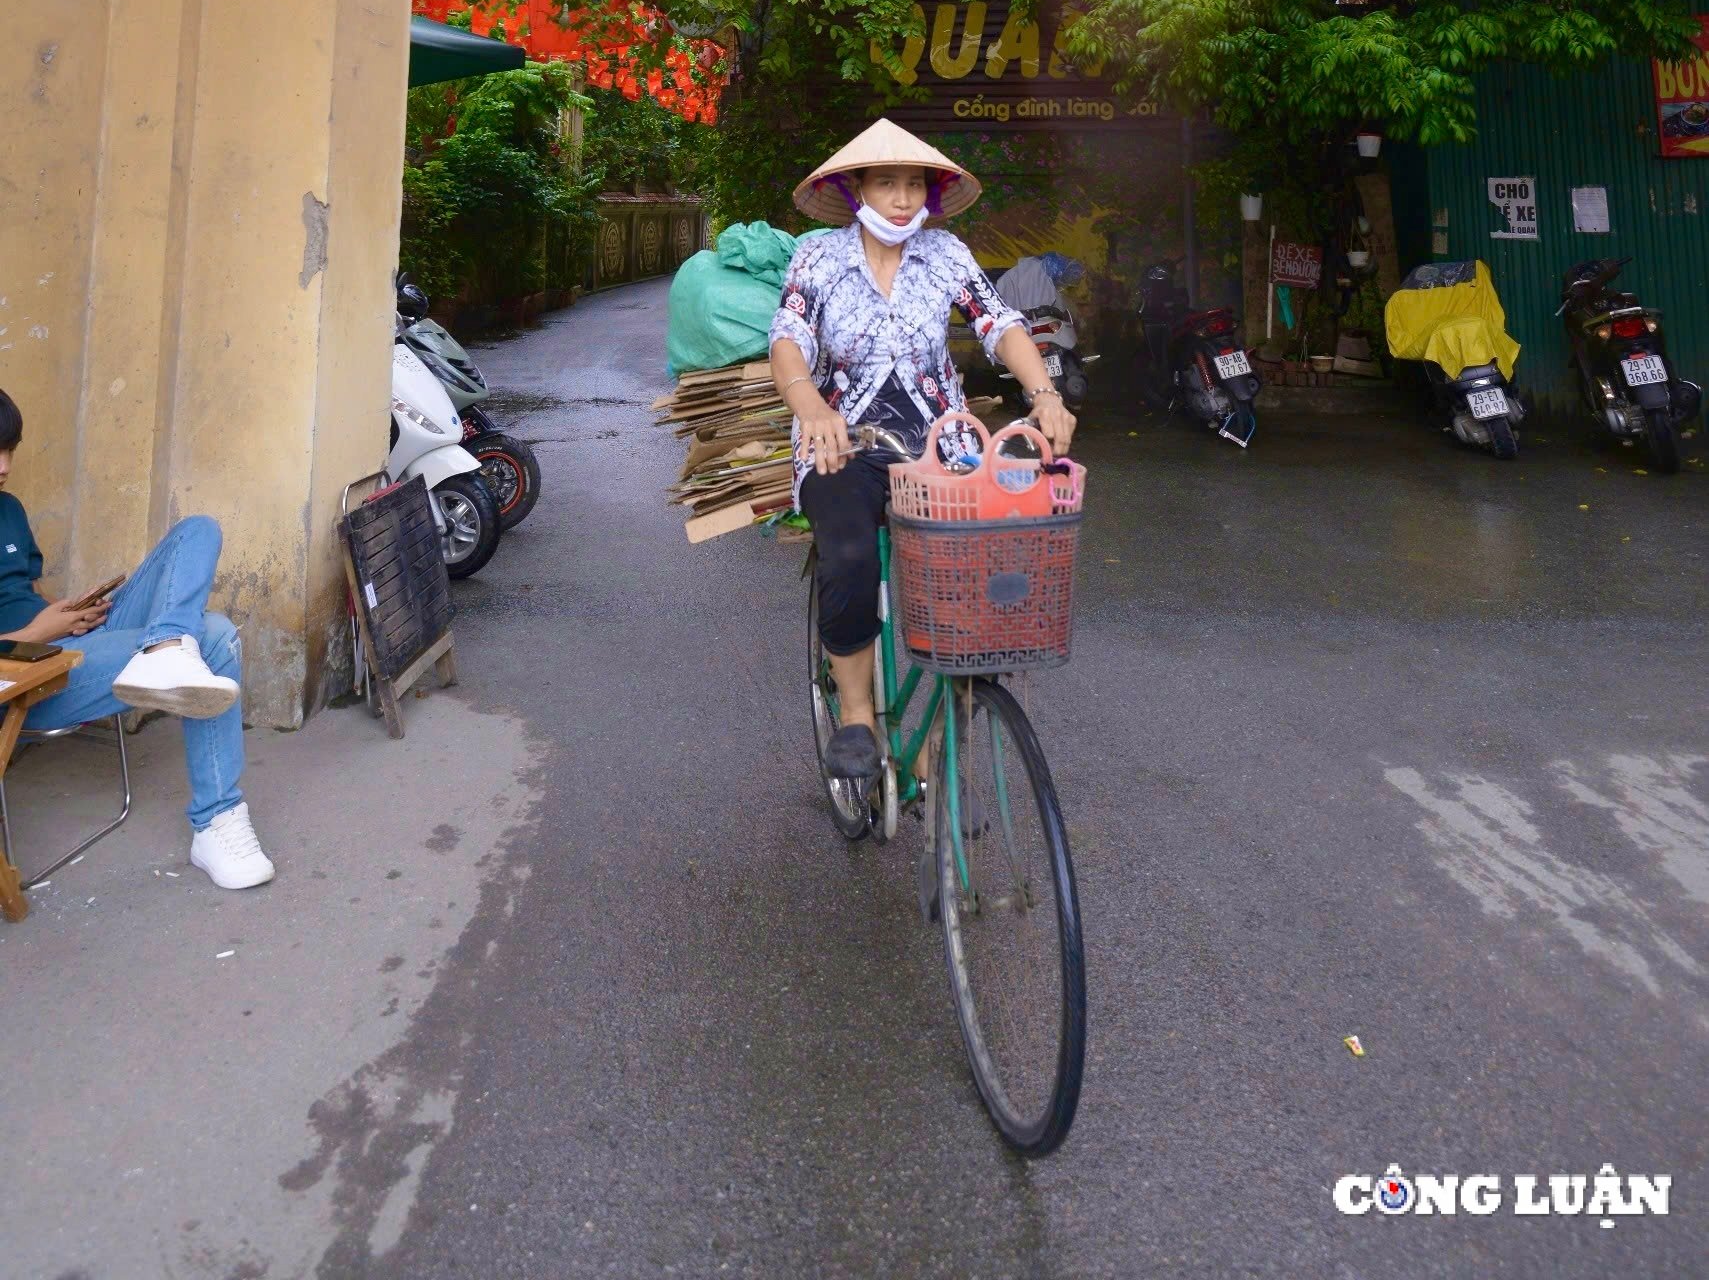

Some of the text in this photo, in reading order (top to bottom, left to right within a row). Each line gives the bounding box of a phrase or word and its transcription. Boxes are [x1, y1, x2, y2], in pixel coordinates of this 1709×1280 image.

[954, 93, 1010, 121] Cổng
[1016, 96, 1061, 117] đình
[1067, 97, 1114, 121] làng
[1516, 206, 1535, 221] XE
[1295, 248, 1312, 261] XE
[1221, 362, 1248, 377] 127.67
[1628, 369, 1664, 383] 368.66
